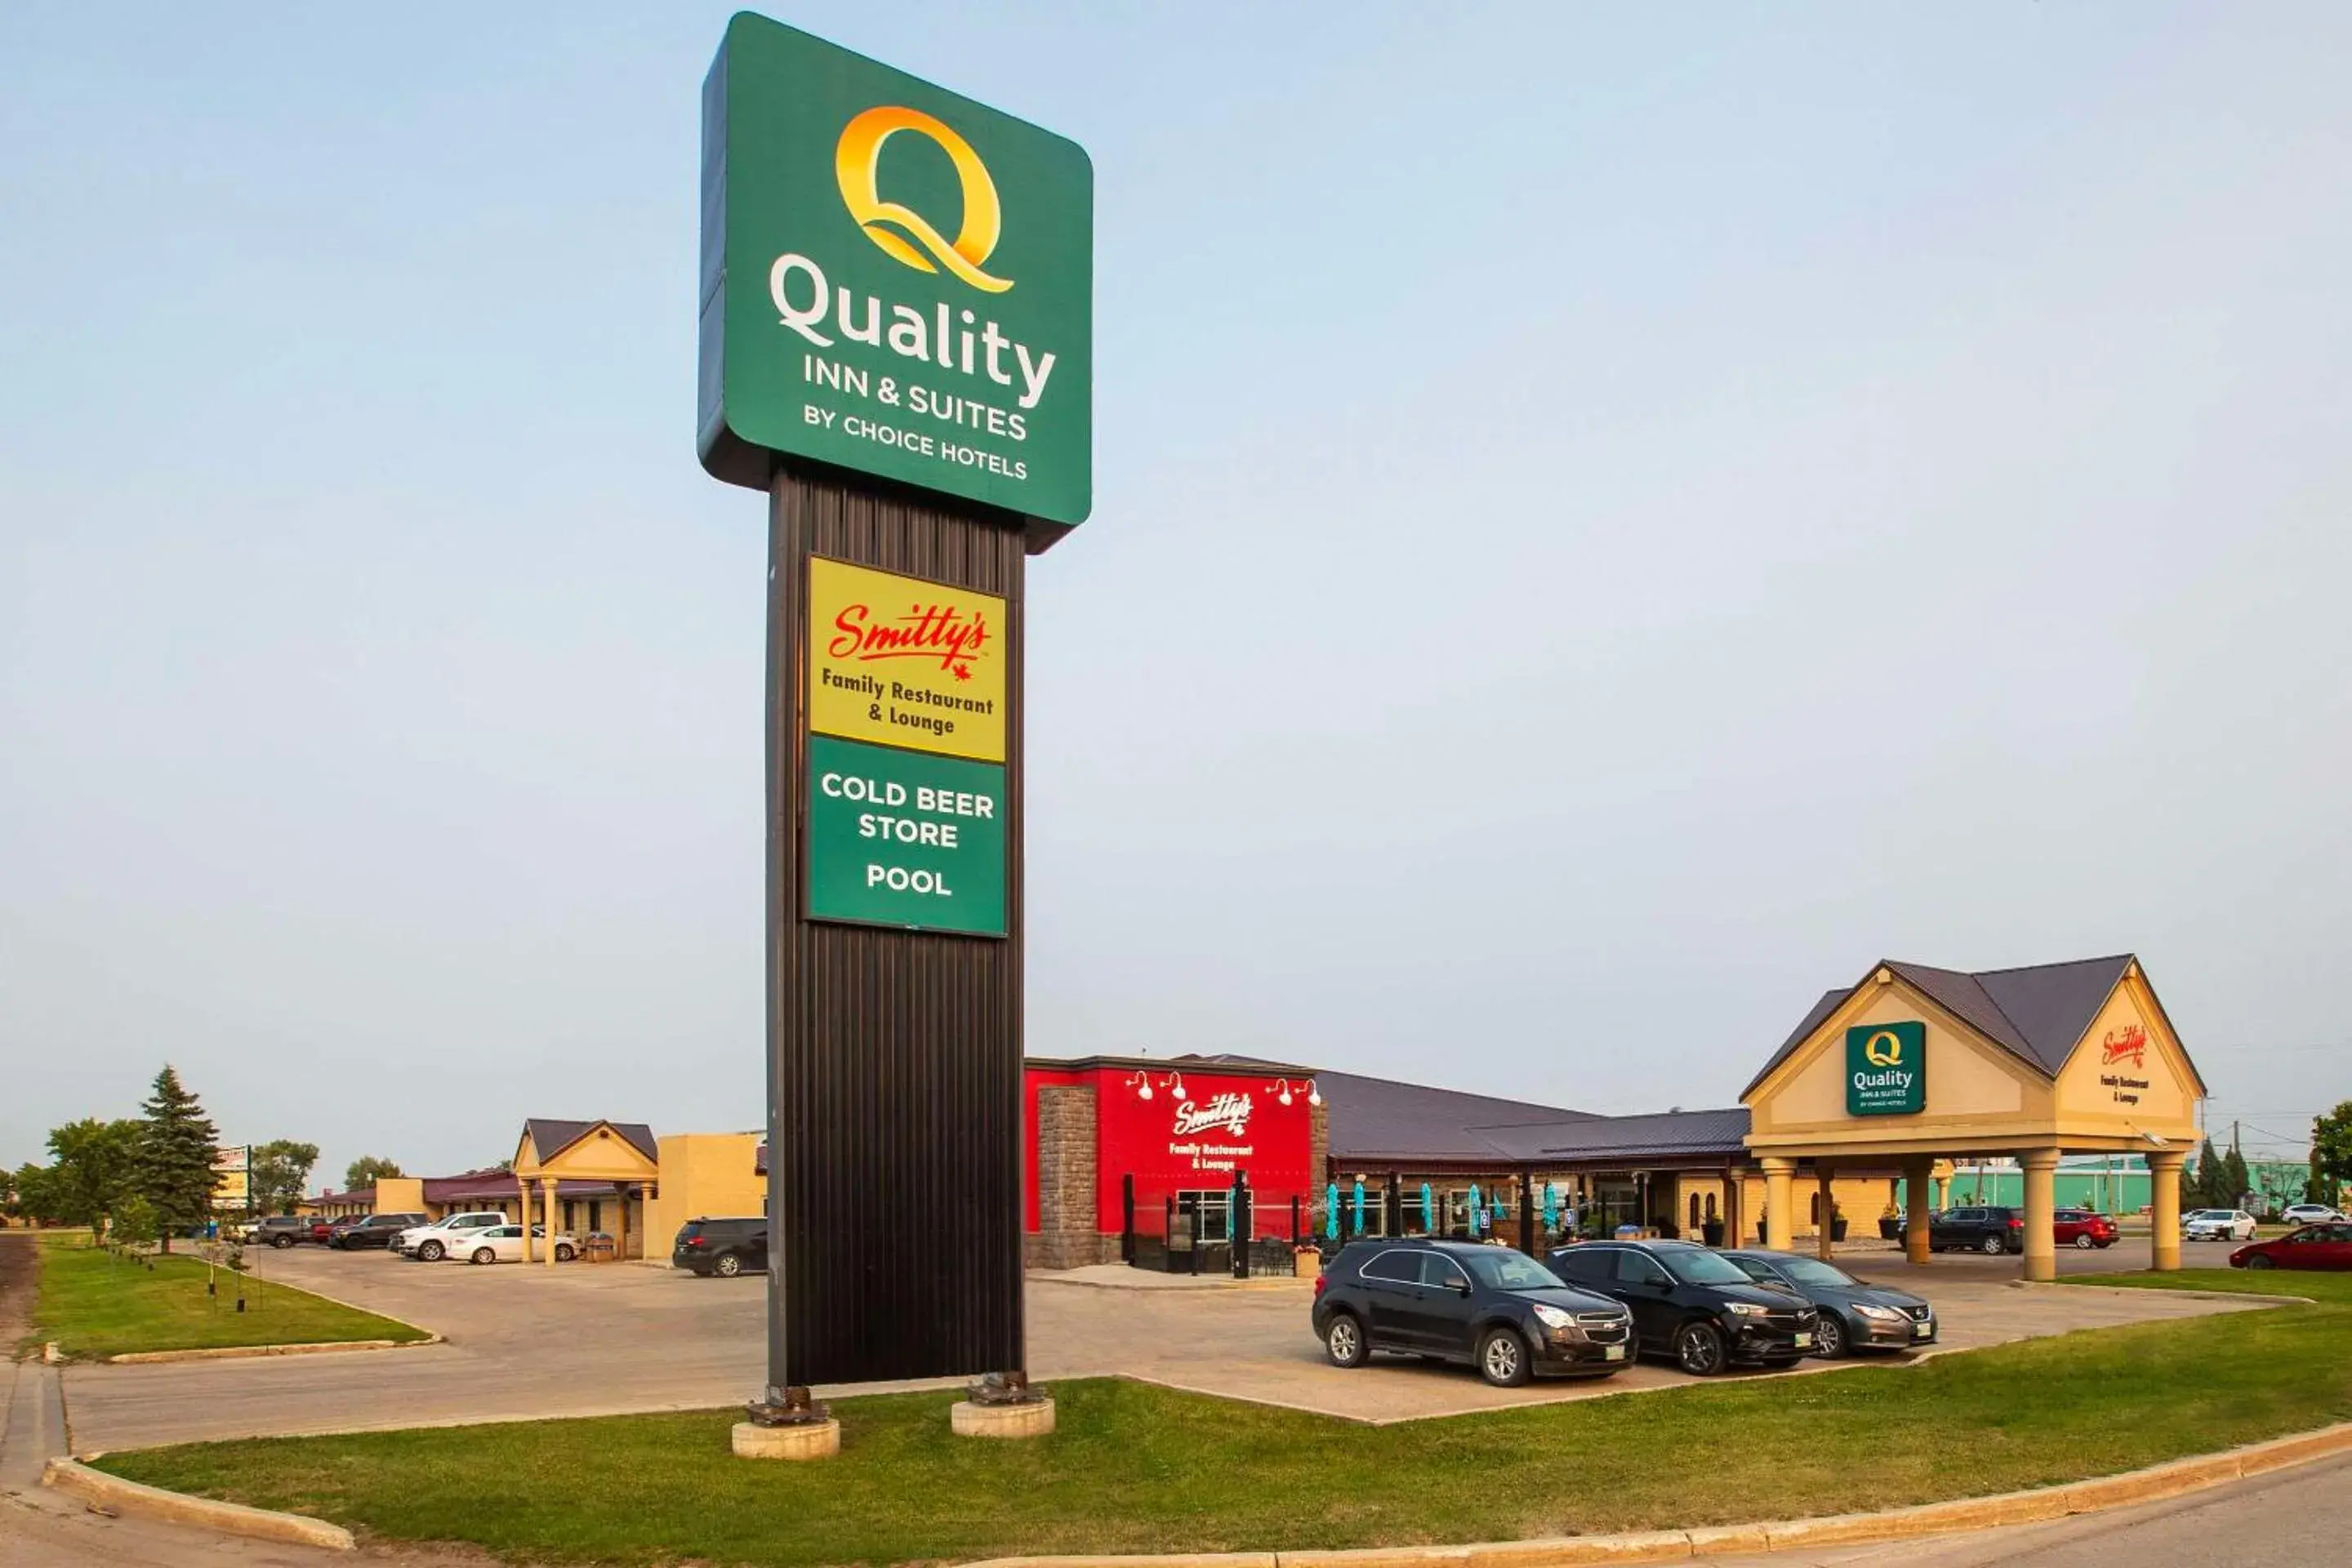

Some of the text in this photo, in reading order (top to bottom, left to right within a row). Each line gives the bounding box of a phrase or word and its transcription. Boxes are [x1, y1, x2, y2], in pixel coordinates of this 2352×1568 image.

[769, 253, 1056, 408] Quality
[804, 354, 1027, 441] INN & SUITES
[804, 403, 1027, 480] BY CHOICE HOTELS
[828, 603, 991, 671] Smitty's
[822, 667, 994, 715] Family Restaurant
[868, 703, 955, 736] & Lounge
[821, 772, 995, 819] COLD BEER
[858, 813, 959, 849] STORE
[866, 864, 953, 897] POOL
[1854, 1071, 1913, 1090] Quality
[1173, 1092, 1254, 1134] Smitty's
[1169, 1143, 1254, 1157] Family Restaurant
[1201, 1158, 1236, 1172] Lounge
